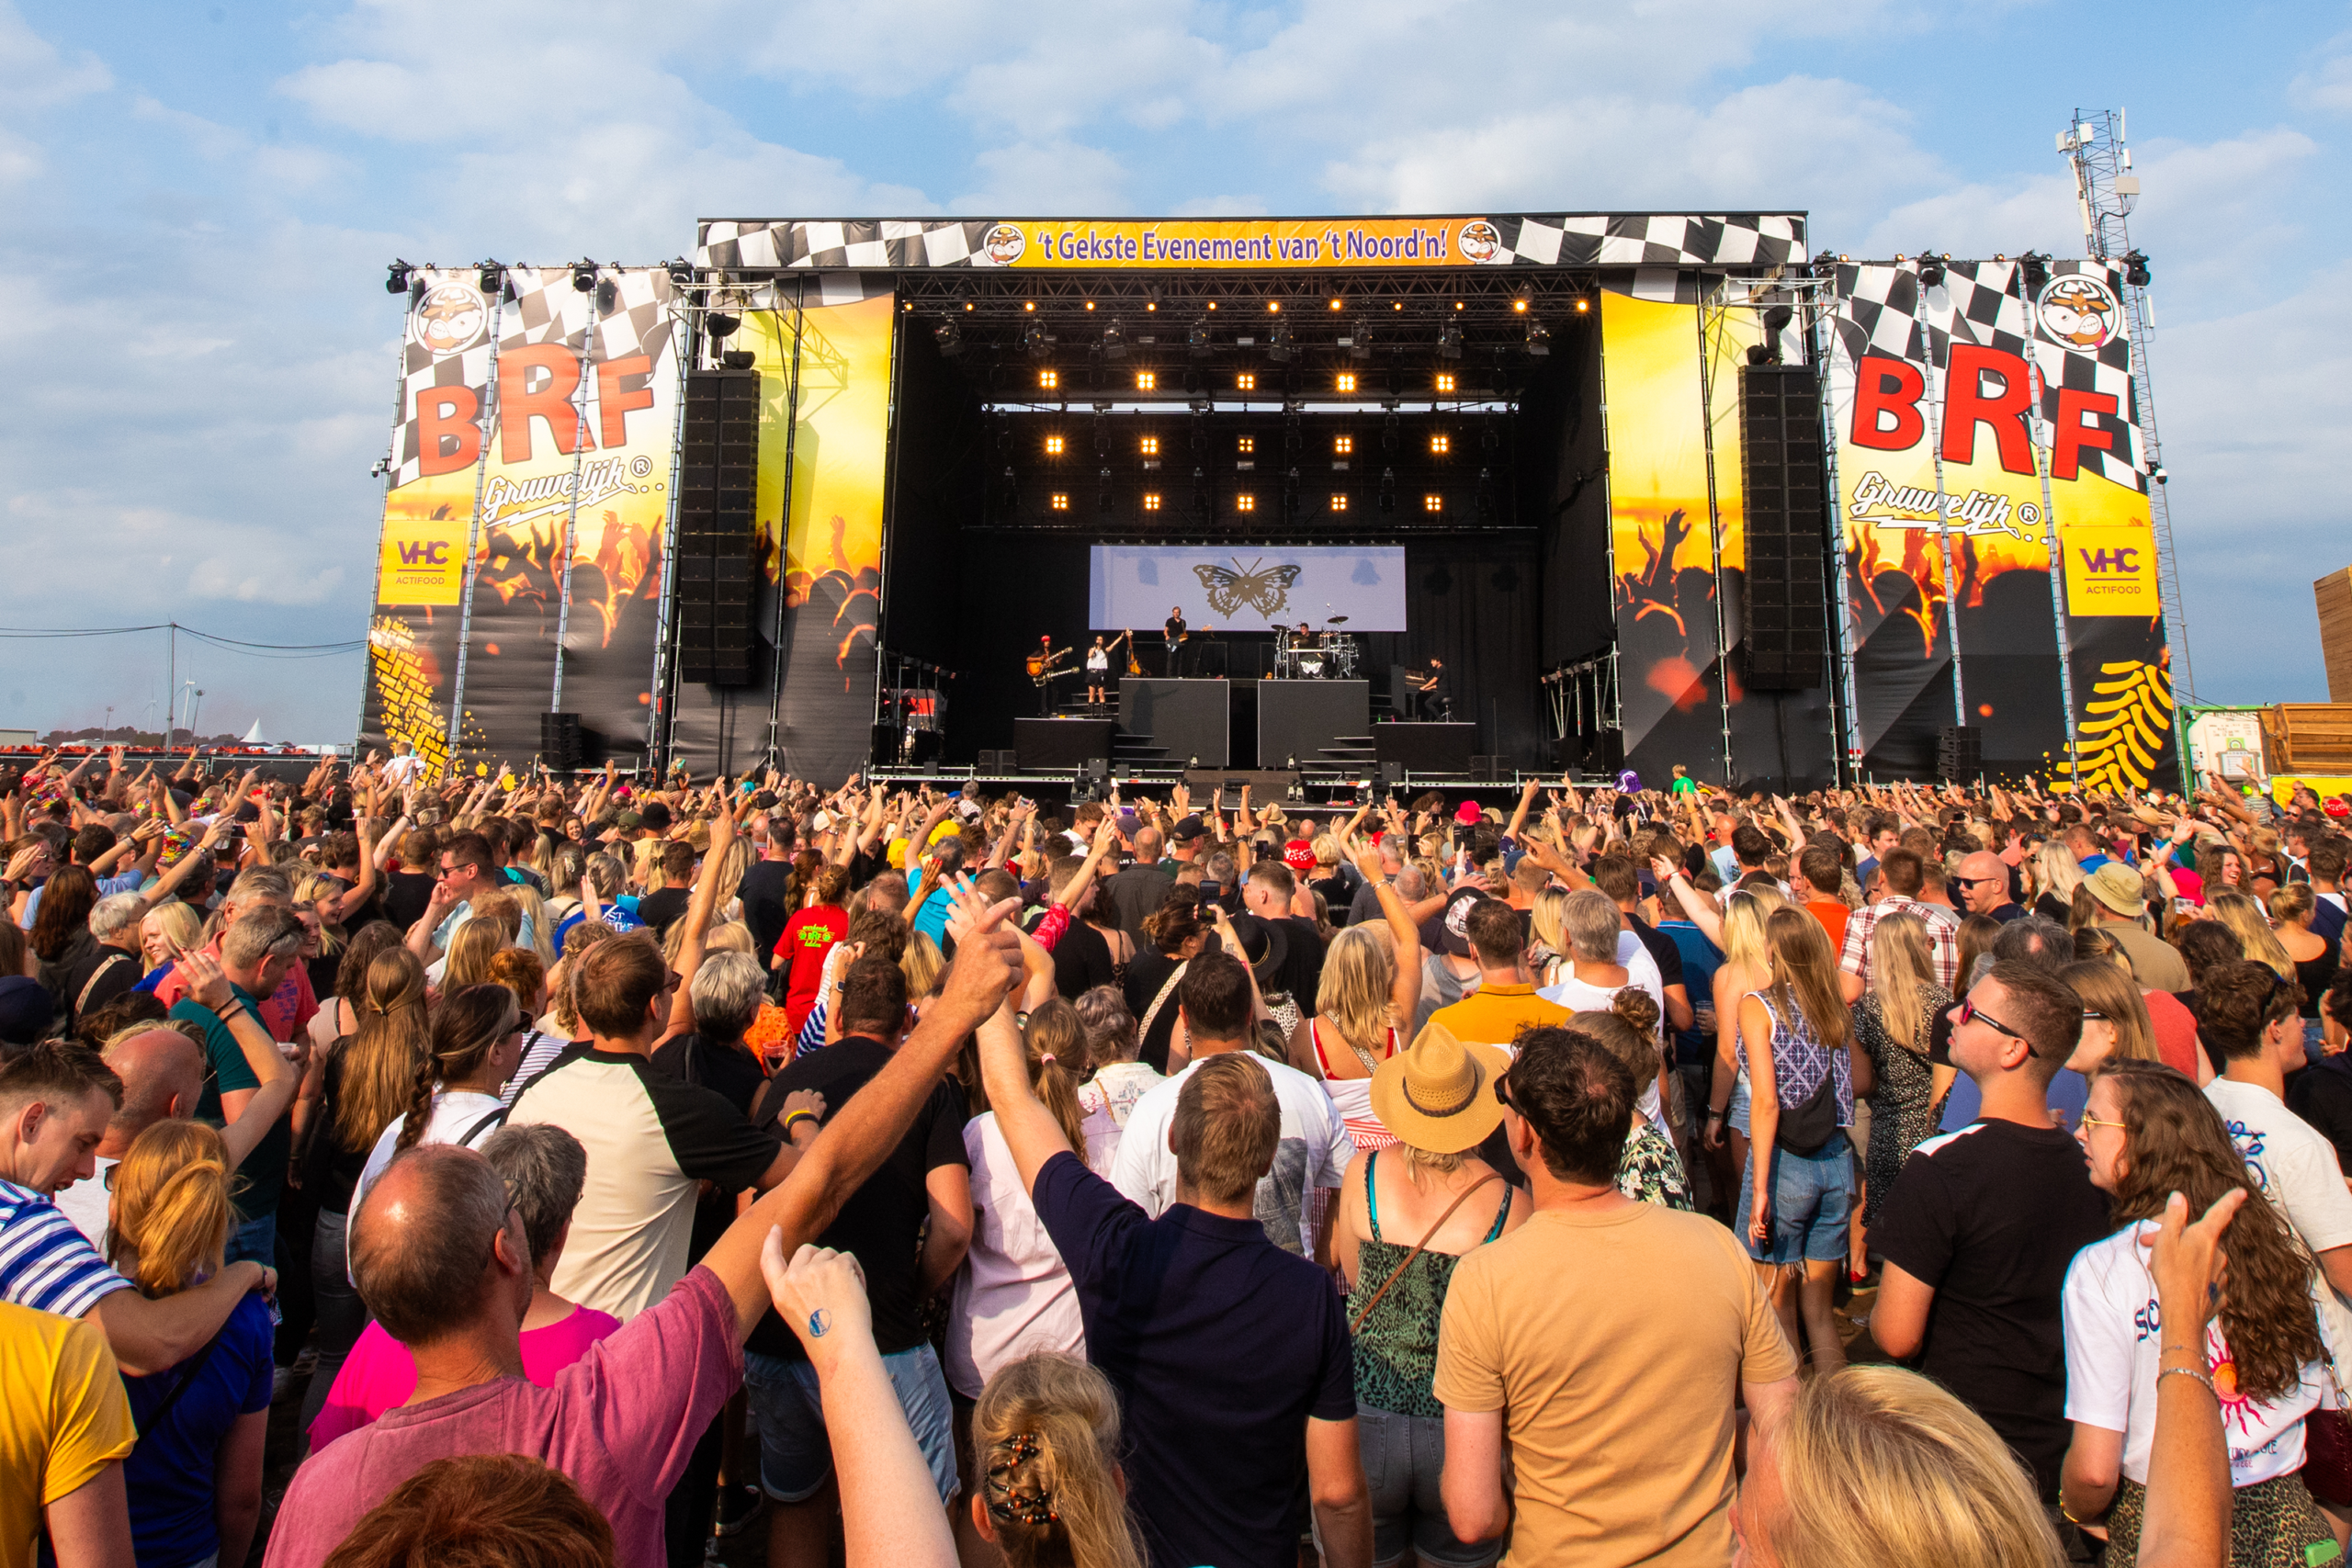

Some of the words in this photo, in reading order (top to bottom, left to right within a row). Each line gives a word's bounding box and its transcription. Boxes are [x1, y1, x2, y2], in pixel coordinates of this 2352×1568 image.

[1057, 231, 1137, 261] Gekste
[1142, 231, 1272, 261] Evenement
[1277, 238, 1319, 260] van
[1346, 228, 1447, 259] Noord'n!
[416, 342, 655, 478] BRF
[1849, 342, 2119, 481] BRF
[397, 540, 450, 565] VHC
[2078, 547, 2142, 573] VHC
[395, 576, 446, 585] ACTIFOOD
[2086, 586, 2142, 594] ACTIFOOD
